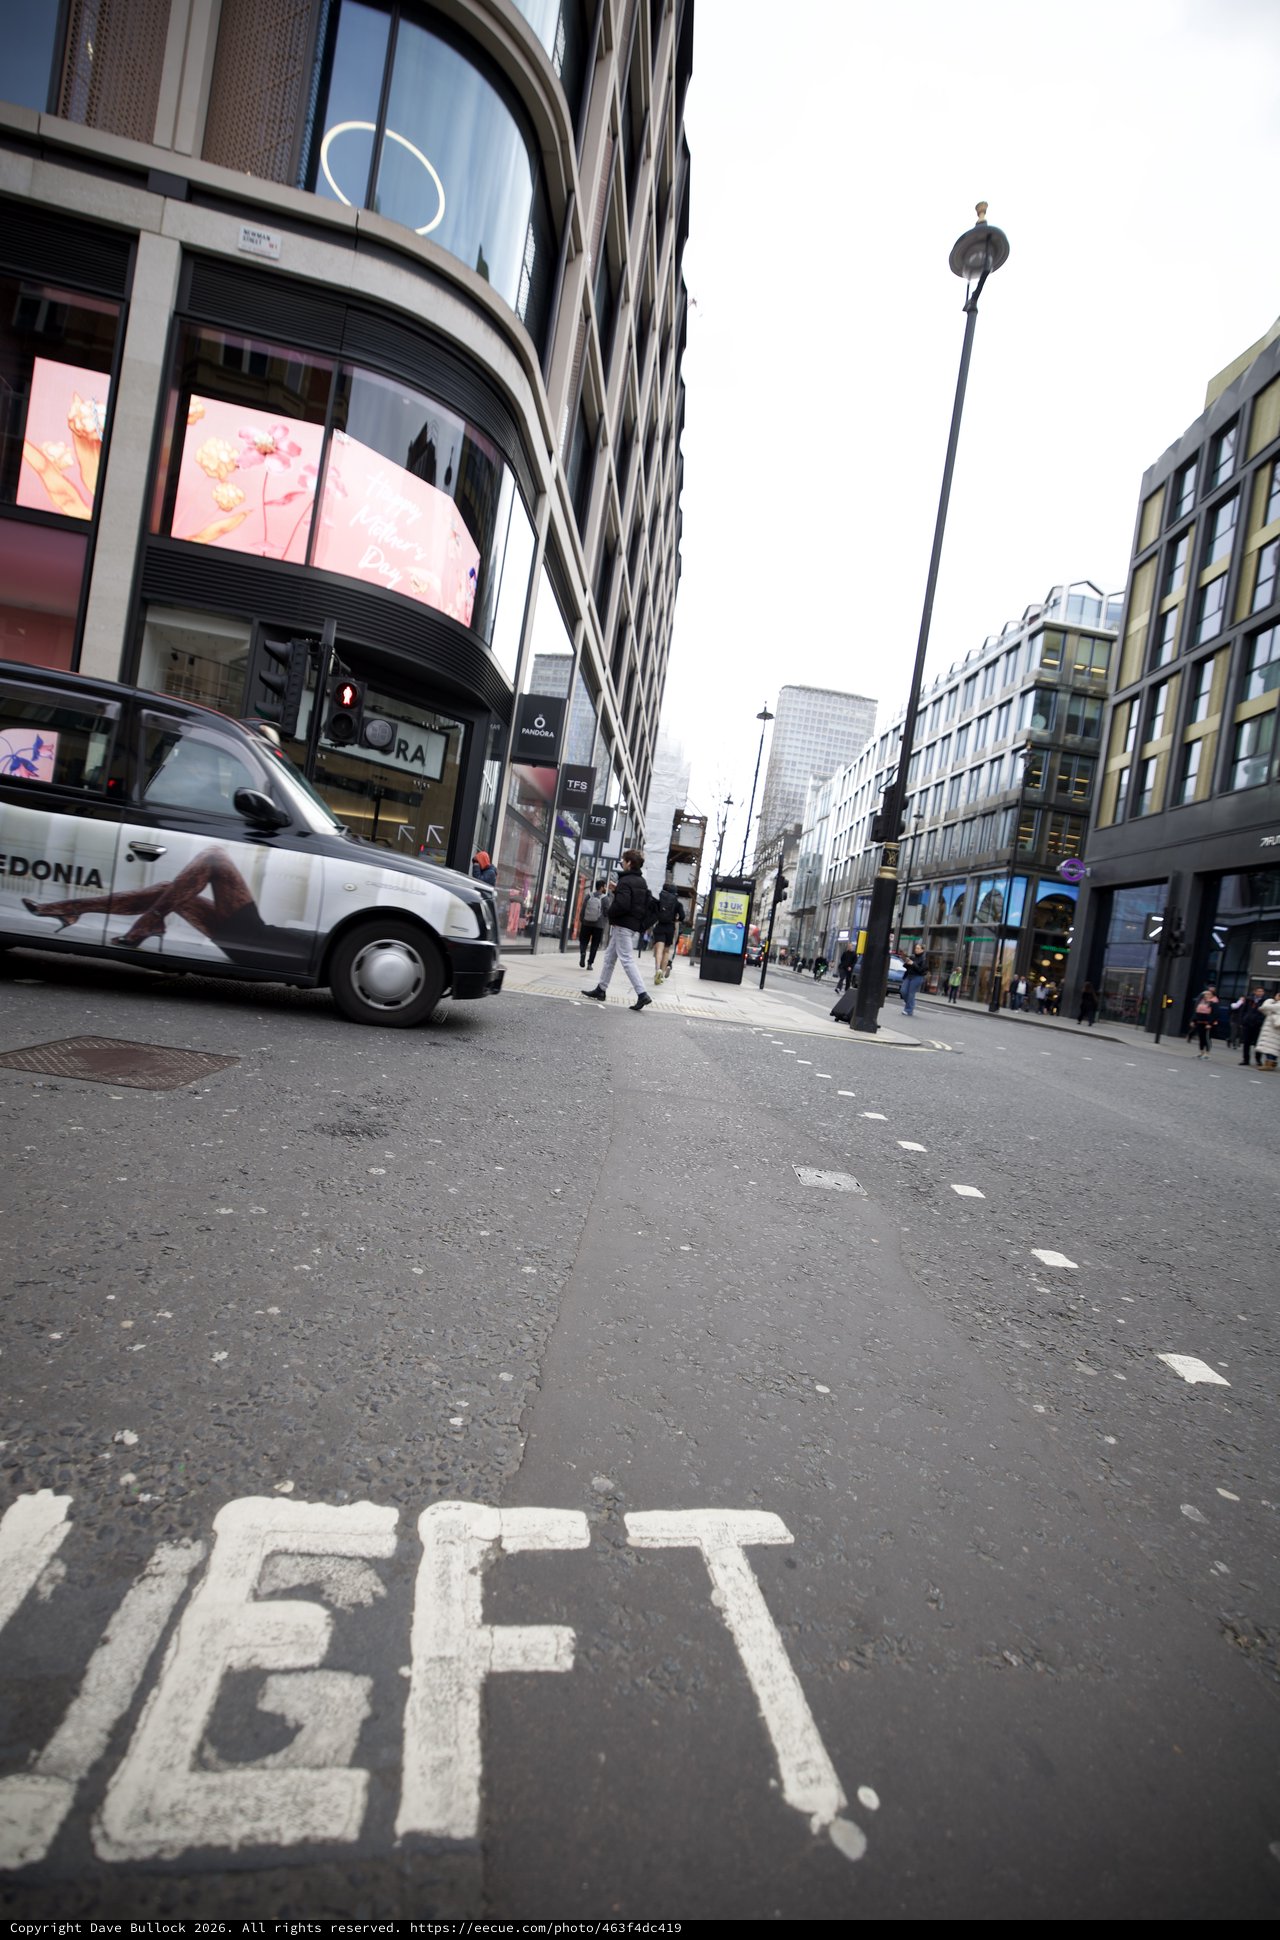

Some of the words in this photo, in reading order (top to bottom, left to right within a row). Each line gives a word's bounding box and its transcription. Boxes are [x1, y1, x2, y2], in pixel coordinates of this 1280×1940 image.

[366, 471, 422, 525] Happy
[358, 545, 402, 589] Day
[567, 779, 588, 790] TFS
[590, 815, 607, 825] TFS
